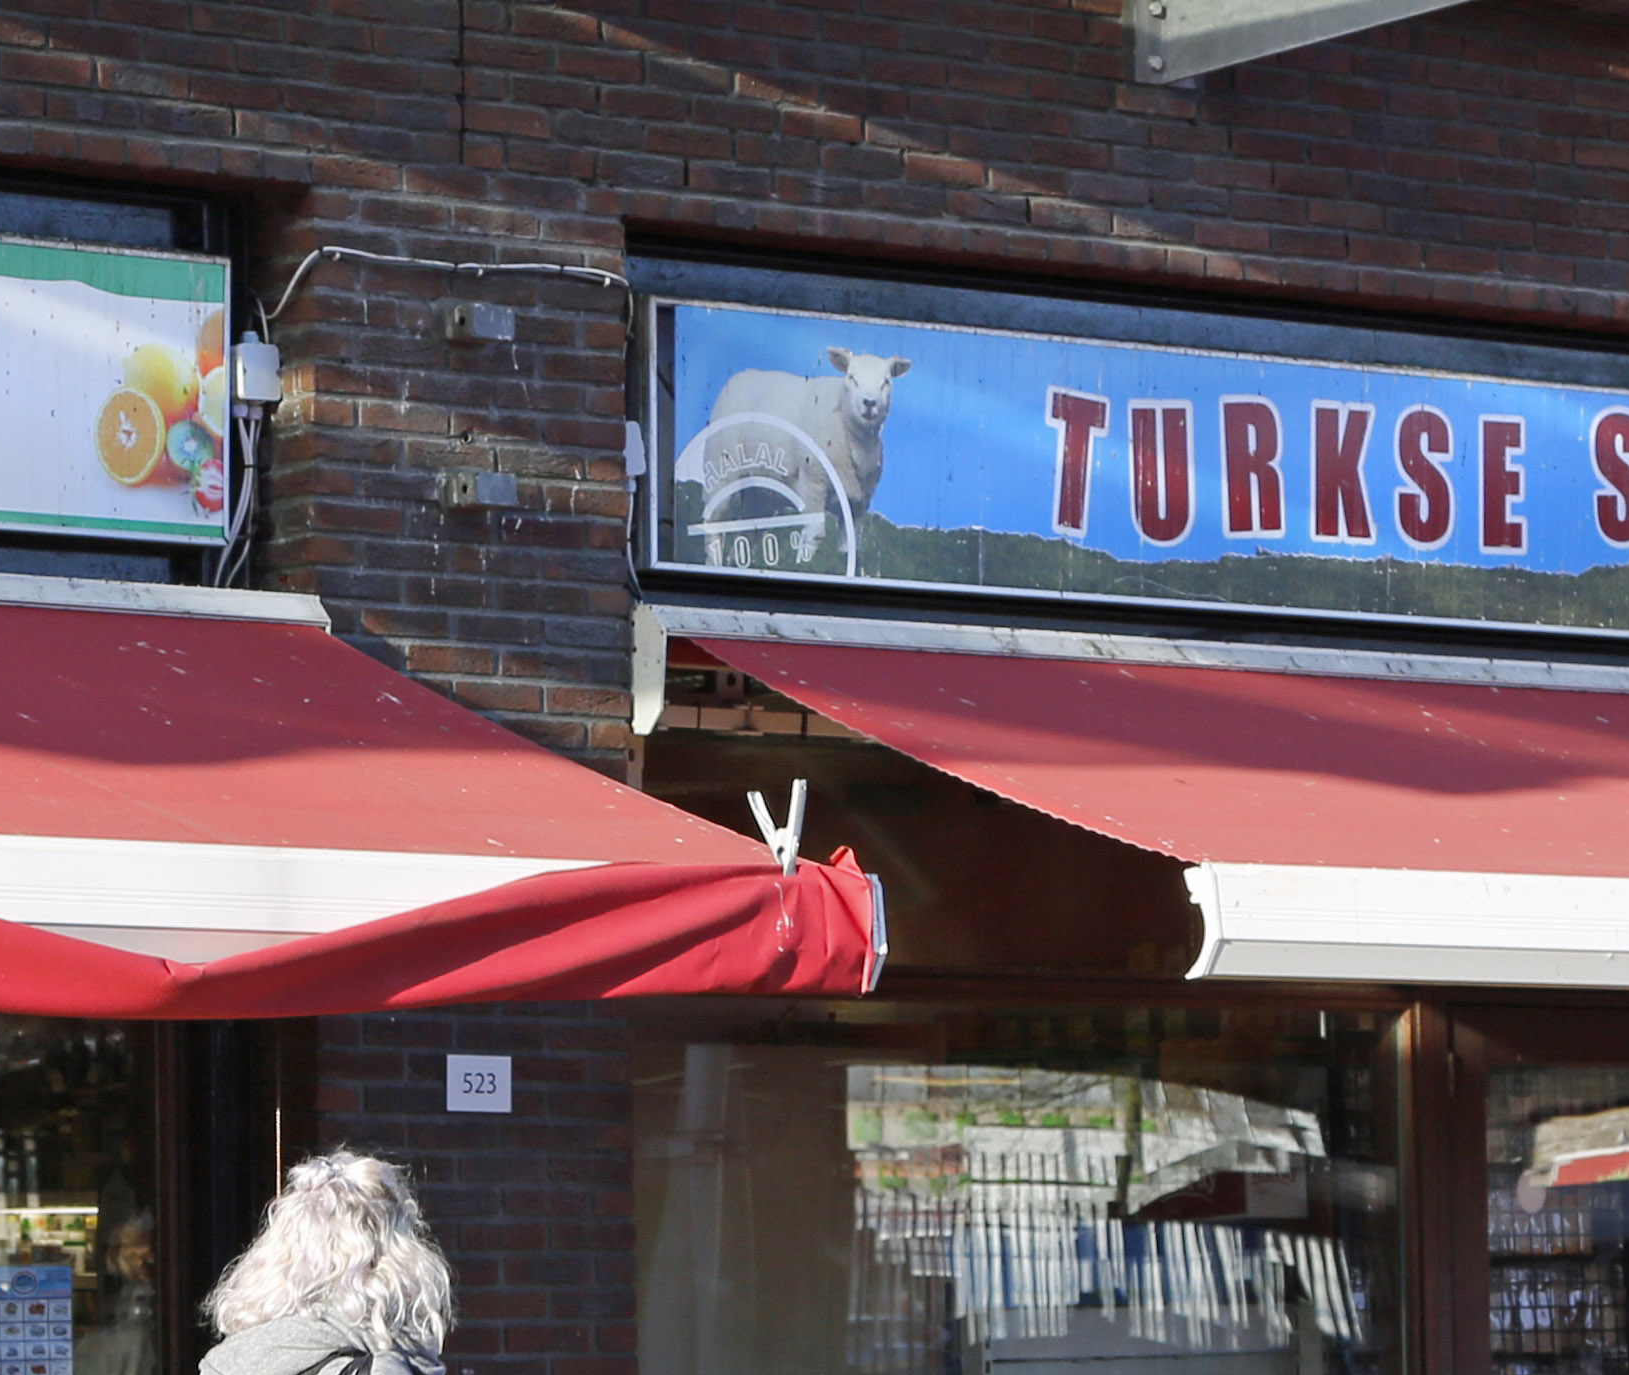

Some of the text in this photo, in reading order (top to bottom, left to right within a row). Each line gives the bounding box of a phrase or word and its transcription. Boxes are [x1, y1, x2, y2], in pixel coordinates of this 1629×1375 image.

[703, 443, 788, 493] HALAL
[1045, 385, 1527, 556] TURKSE
[709, 531, 812, 568] 100%
[463, 1072, 497, 1095] 523
